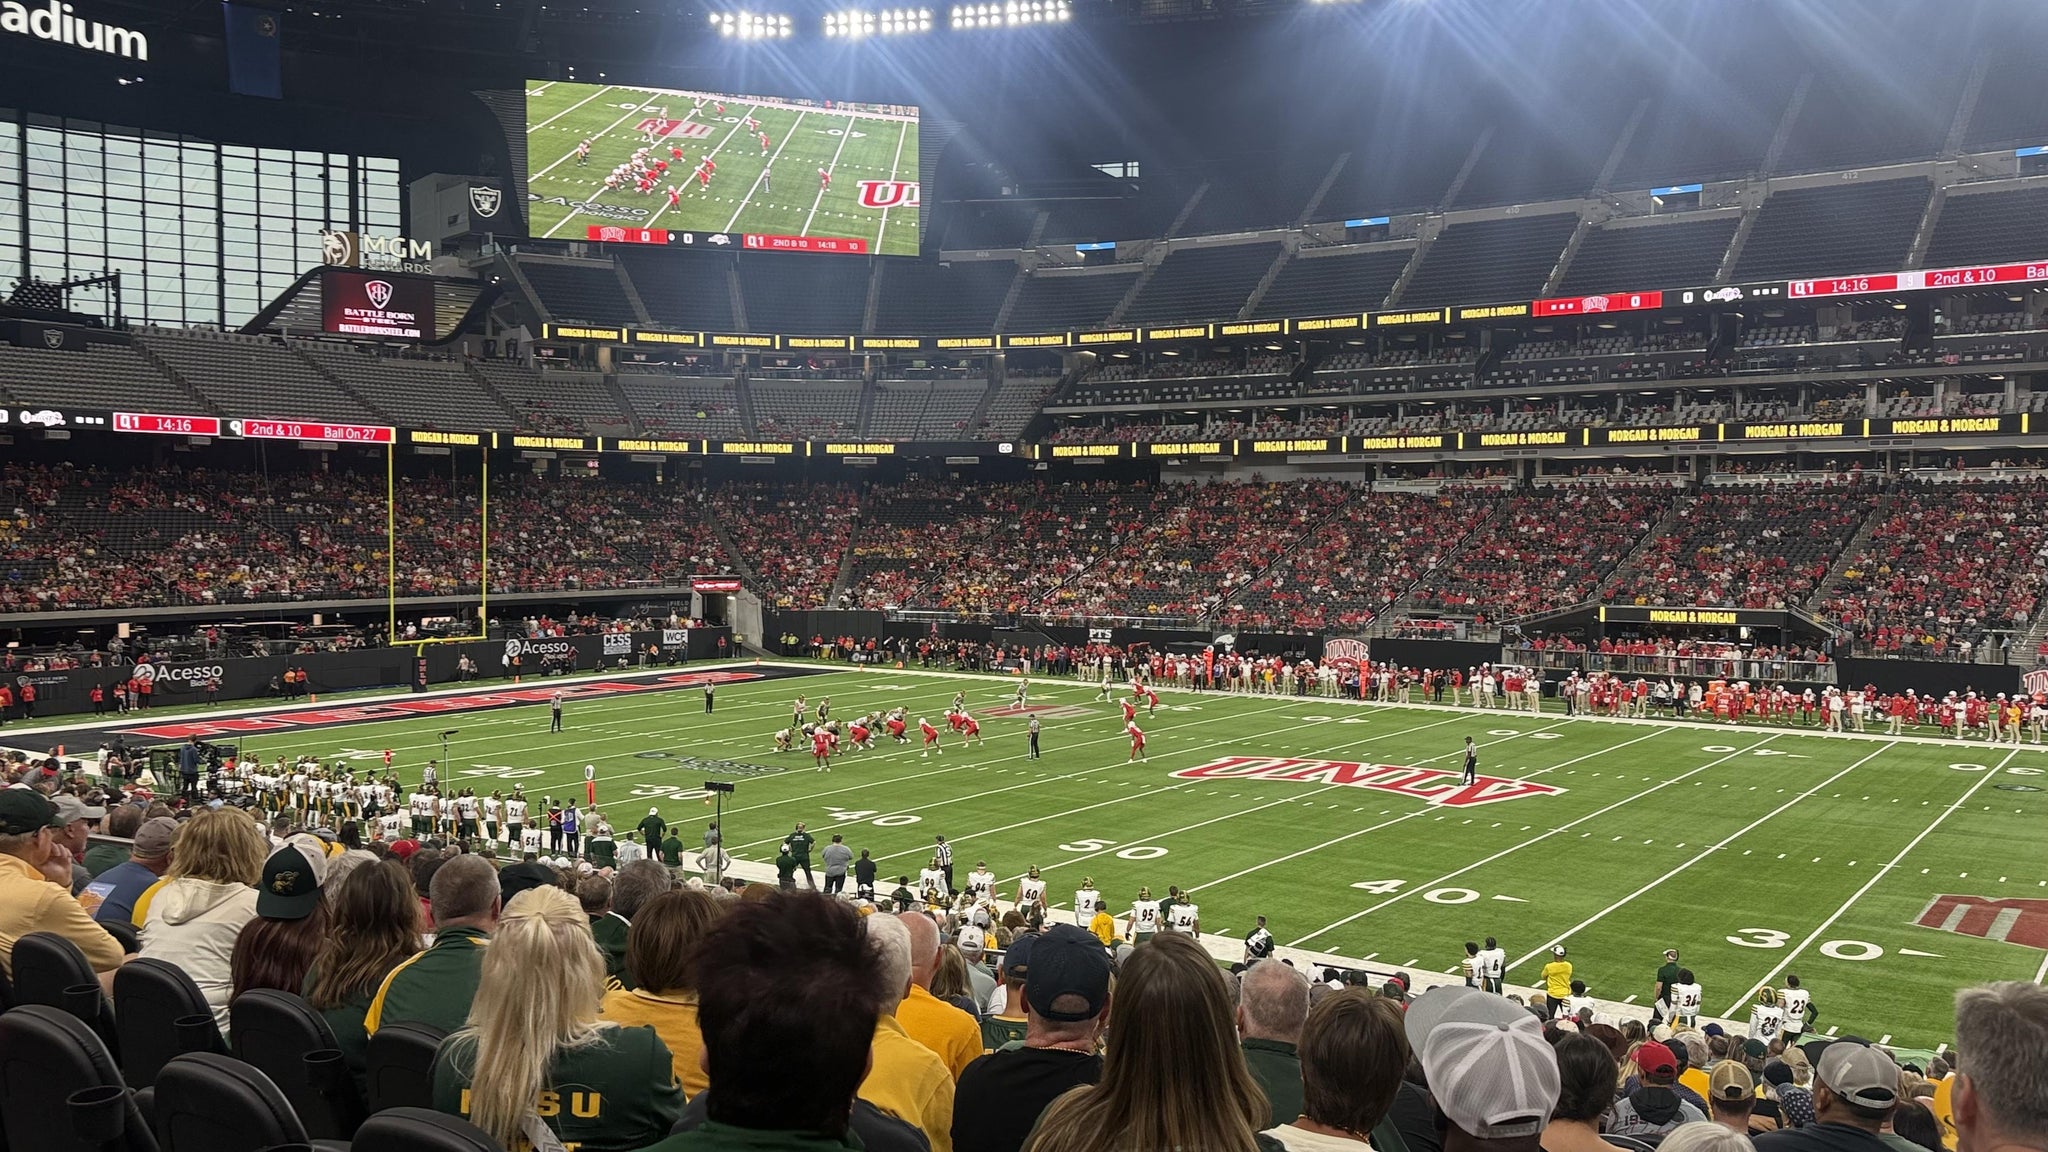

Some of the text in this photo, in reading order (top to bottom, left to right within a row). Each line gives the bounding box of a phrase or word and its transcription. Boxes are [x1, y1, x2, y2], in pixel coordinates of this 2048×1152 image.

[600, 226, 627, 242] UNLV
[363, 234, 432, 261] MGM
[747, 236, 765, 248] Q1
[773, 239, 790, 248] 2ND
[1933, 269, 1996, 286] 2nd & 10
[1794, 282, 1814, 296] Q1
[1831, 279, 1869, 293] 14:16
[1581, 296, 1610, 313] UNLV
[344, 308, 415, 321] BATTLE BORN
[120, 415, 140, 429] Q1
[156, 418, 192, 432] 14:16
[1892, 417, 1999, 434] MORGAN & MORGAN
[251, 423, 302, 437] 2nd & 10
[324, 427, 377, 440] Ball On 27
[1608, 427, 1700, 442] MORGAN & MORGAN
[1745, 422, 1843, 438] MORGAN & MORGAN
[411, 431, 443, 444] MORGAN
[448, 433, 479, 445] MORGAN
[513, 436, 546, 448] MORGAN
[552, 437, 584, 449] MORGAN
[1363, 436, 1442, 450] MORGAN & MORGAN
[1480, 431, 1566, 446] MORGAN & MORGAN
[618, 440, 650, 451] MORGAN
[657, 441, 689, 452] MORGAN
[722, 442, 755, 453] MORGAN
[761, 443, 793, 454] MORGAN
[826, 443, 857, 454] MORGAN
[863, 443, 895, 454] MORGAN
[1052, 445, 1119, 457] MORGAN & MORGAN
[1150, 442, 1220, 455] MORGAN & MORGAN
[1253, 439, 1327, 452] MORGAN & MORGAN
[1649, 610, 1737, 624] MORGAN & MORGAN
[603, 633, 632, 647] CESS
[665, 631, 686, 642] WCF
[1088, 628, 1112, 639] PTS
[520, 641, 569, 655] Acesso
[155, 665, 224, 682] Acesso
[1167, 755, 1570, 808] UNLV
[925, 878, 935, 888] 99
[1025, 888, 1038, 900] 60
[1084, 899, 1091, 909] 2
[1141, 908, 1155, 922] 95
[1493, 961, 1499, 972] 6
[1790, 999, 1806, 1014] 23
